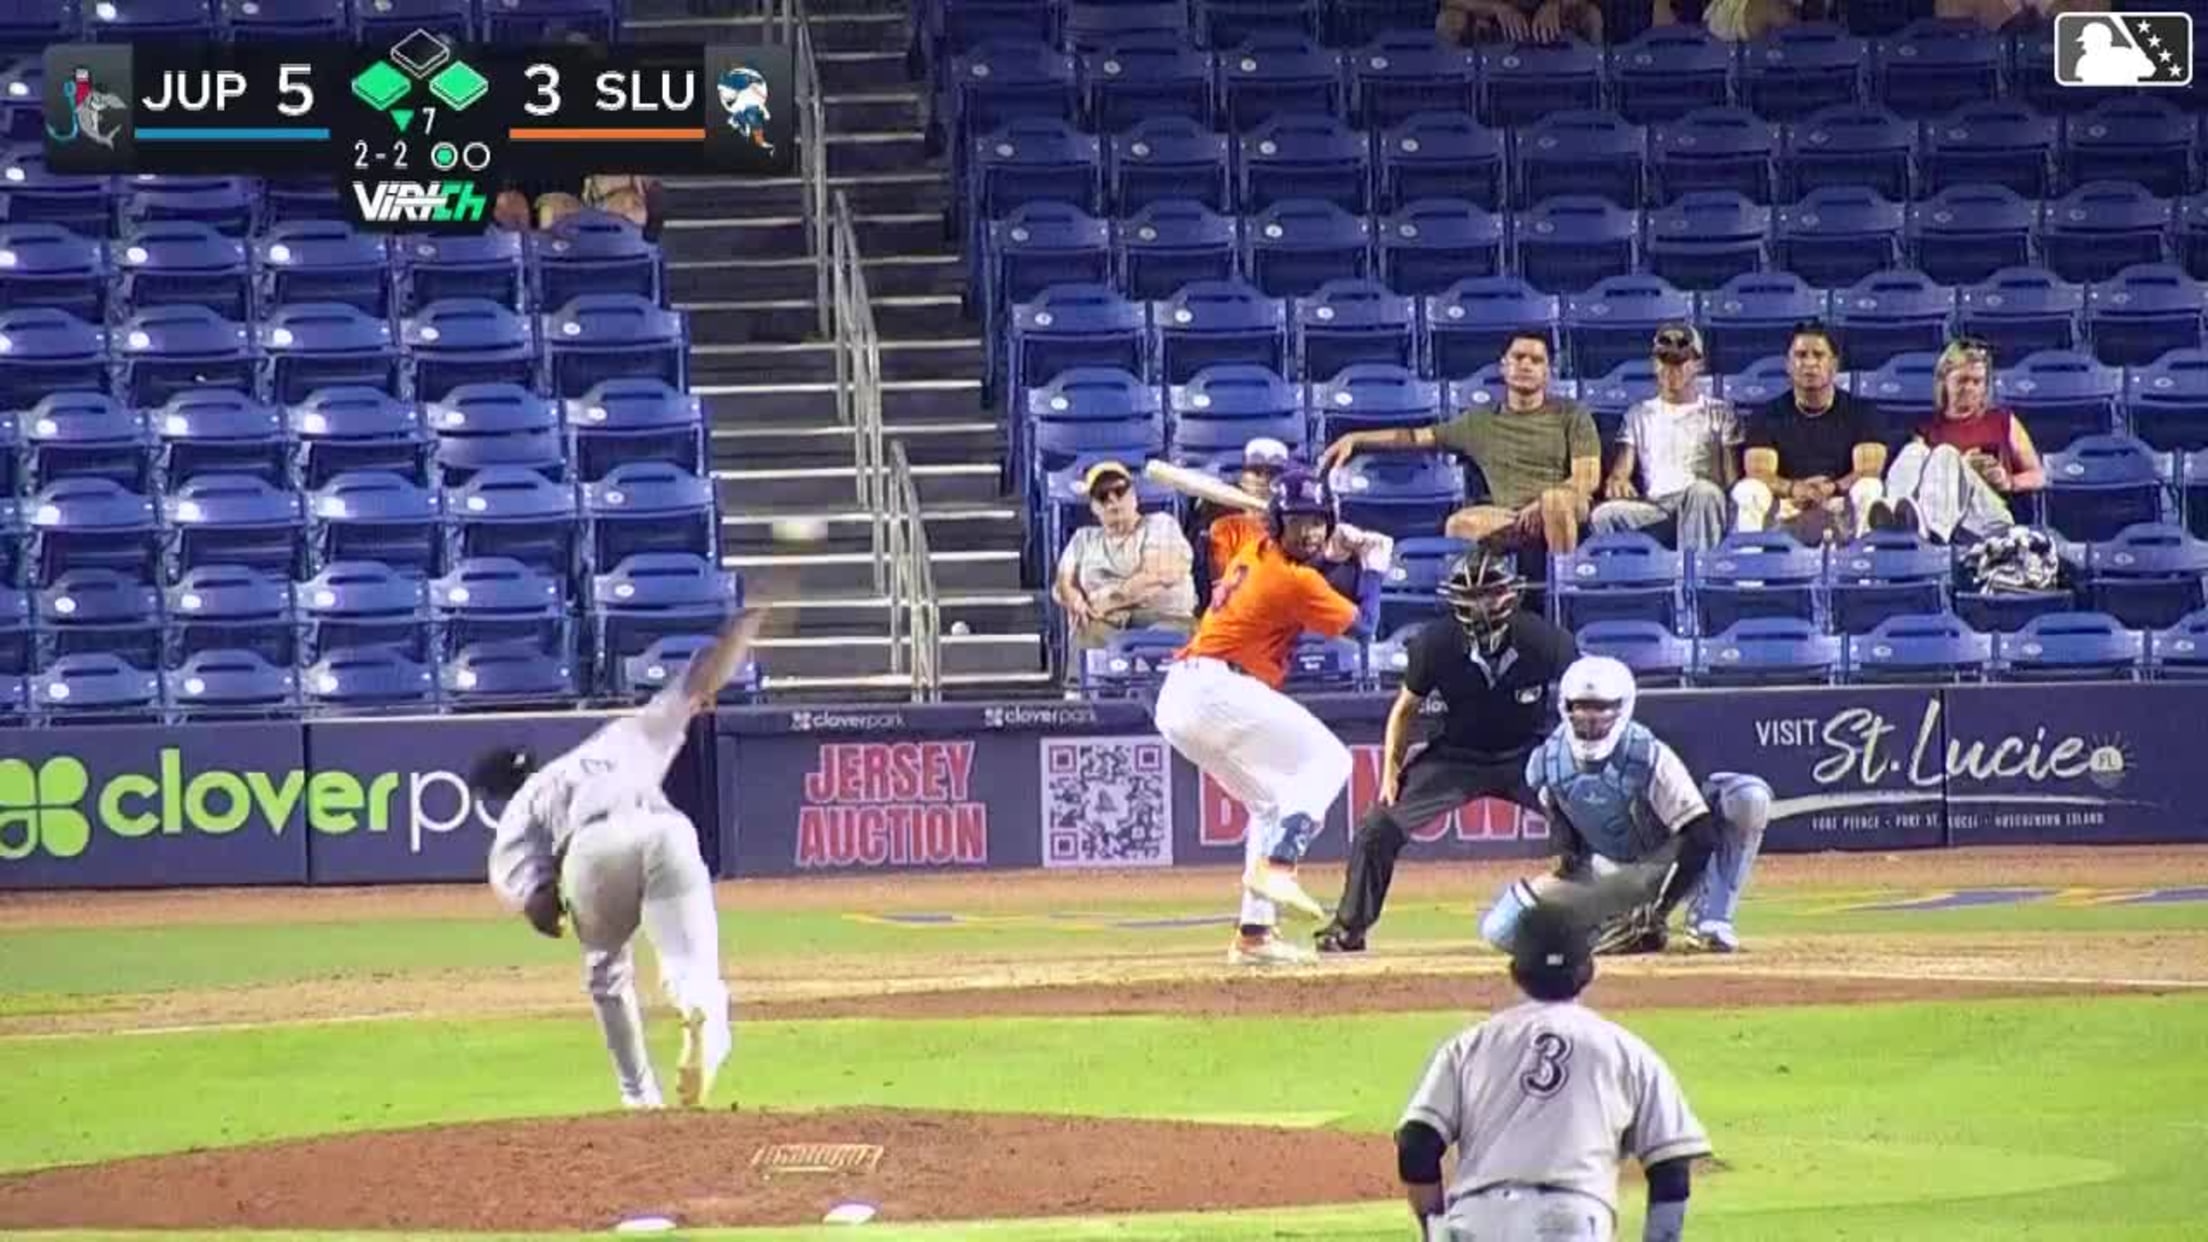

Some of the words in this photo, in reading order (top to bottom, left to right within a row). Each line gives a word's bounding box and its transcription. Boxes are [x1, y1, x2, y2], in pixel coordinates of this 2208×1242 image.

[804, 739, 976, 803] JERSEY
[1755, 719, 1818, 746] VISIT
[1811, 707, 1901, 784] St.
[1908, 698, 2088, 786] Lucie
[795, 802, 988, 867] AUCTION
[1519, 1030, 1573, 1100] 3
